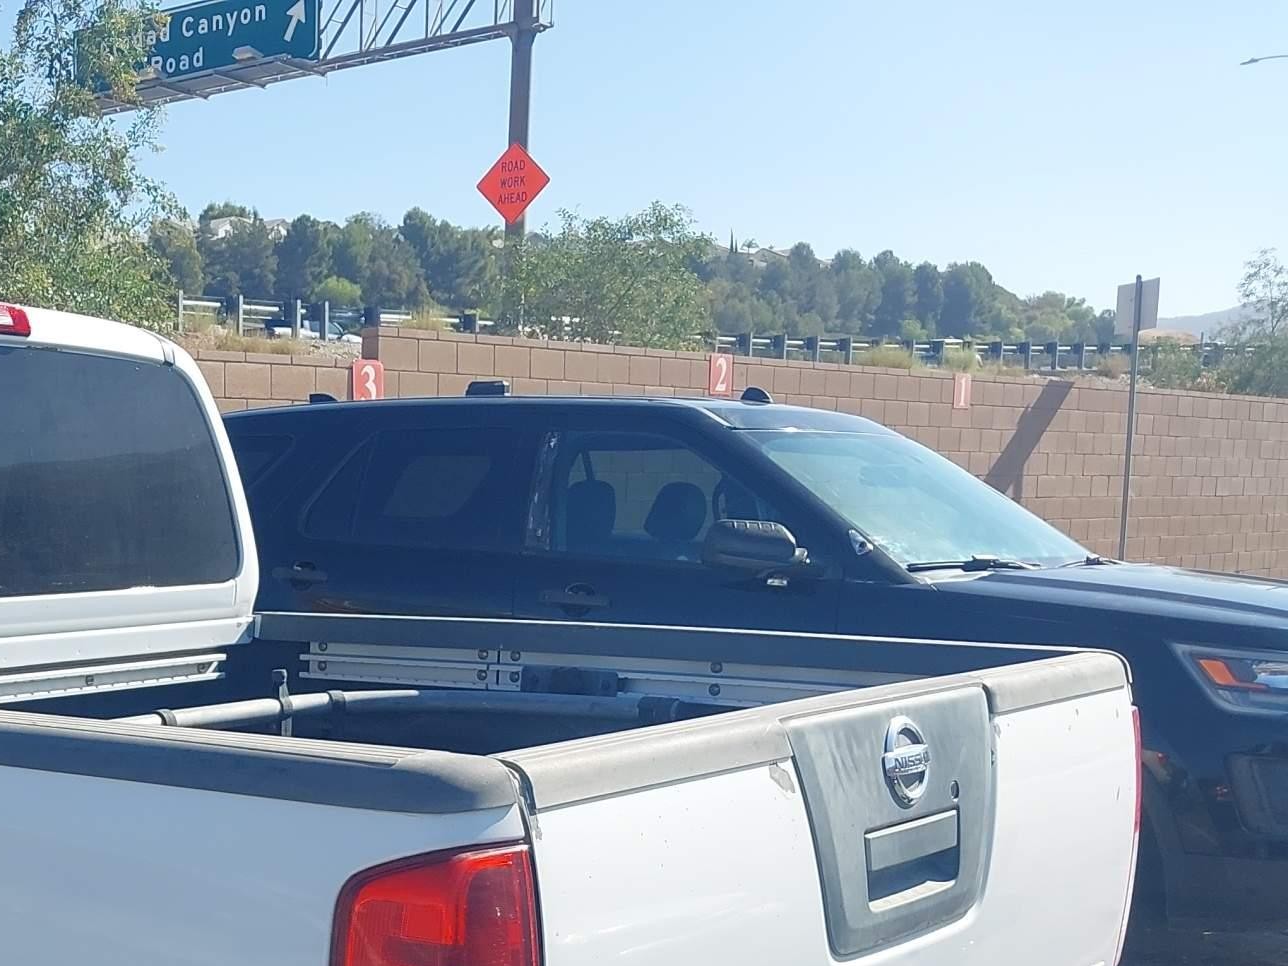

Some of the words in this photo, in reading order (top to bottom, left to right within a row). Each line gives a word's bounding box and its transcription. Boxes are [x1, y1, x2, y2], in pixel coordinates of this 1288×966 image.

[181, 4, 267, 38] Canyon
[150, 46, 204, 75] Road
[501, 160, 526, 173] ROAD
[500, 176, 526, 189] WORK
[497, 191, 527, 205] AHEAD
[360, 364, 377, 400] 3
[714, 357, 728, 392] 2
